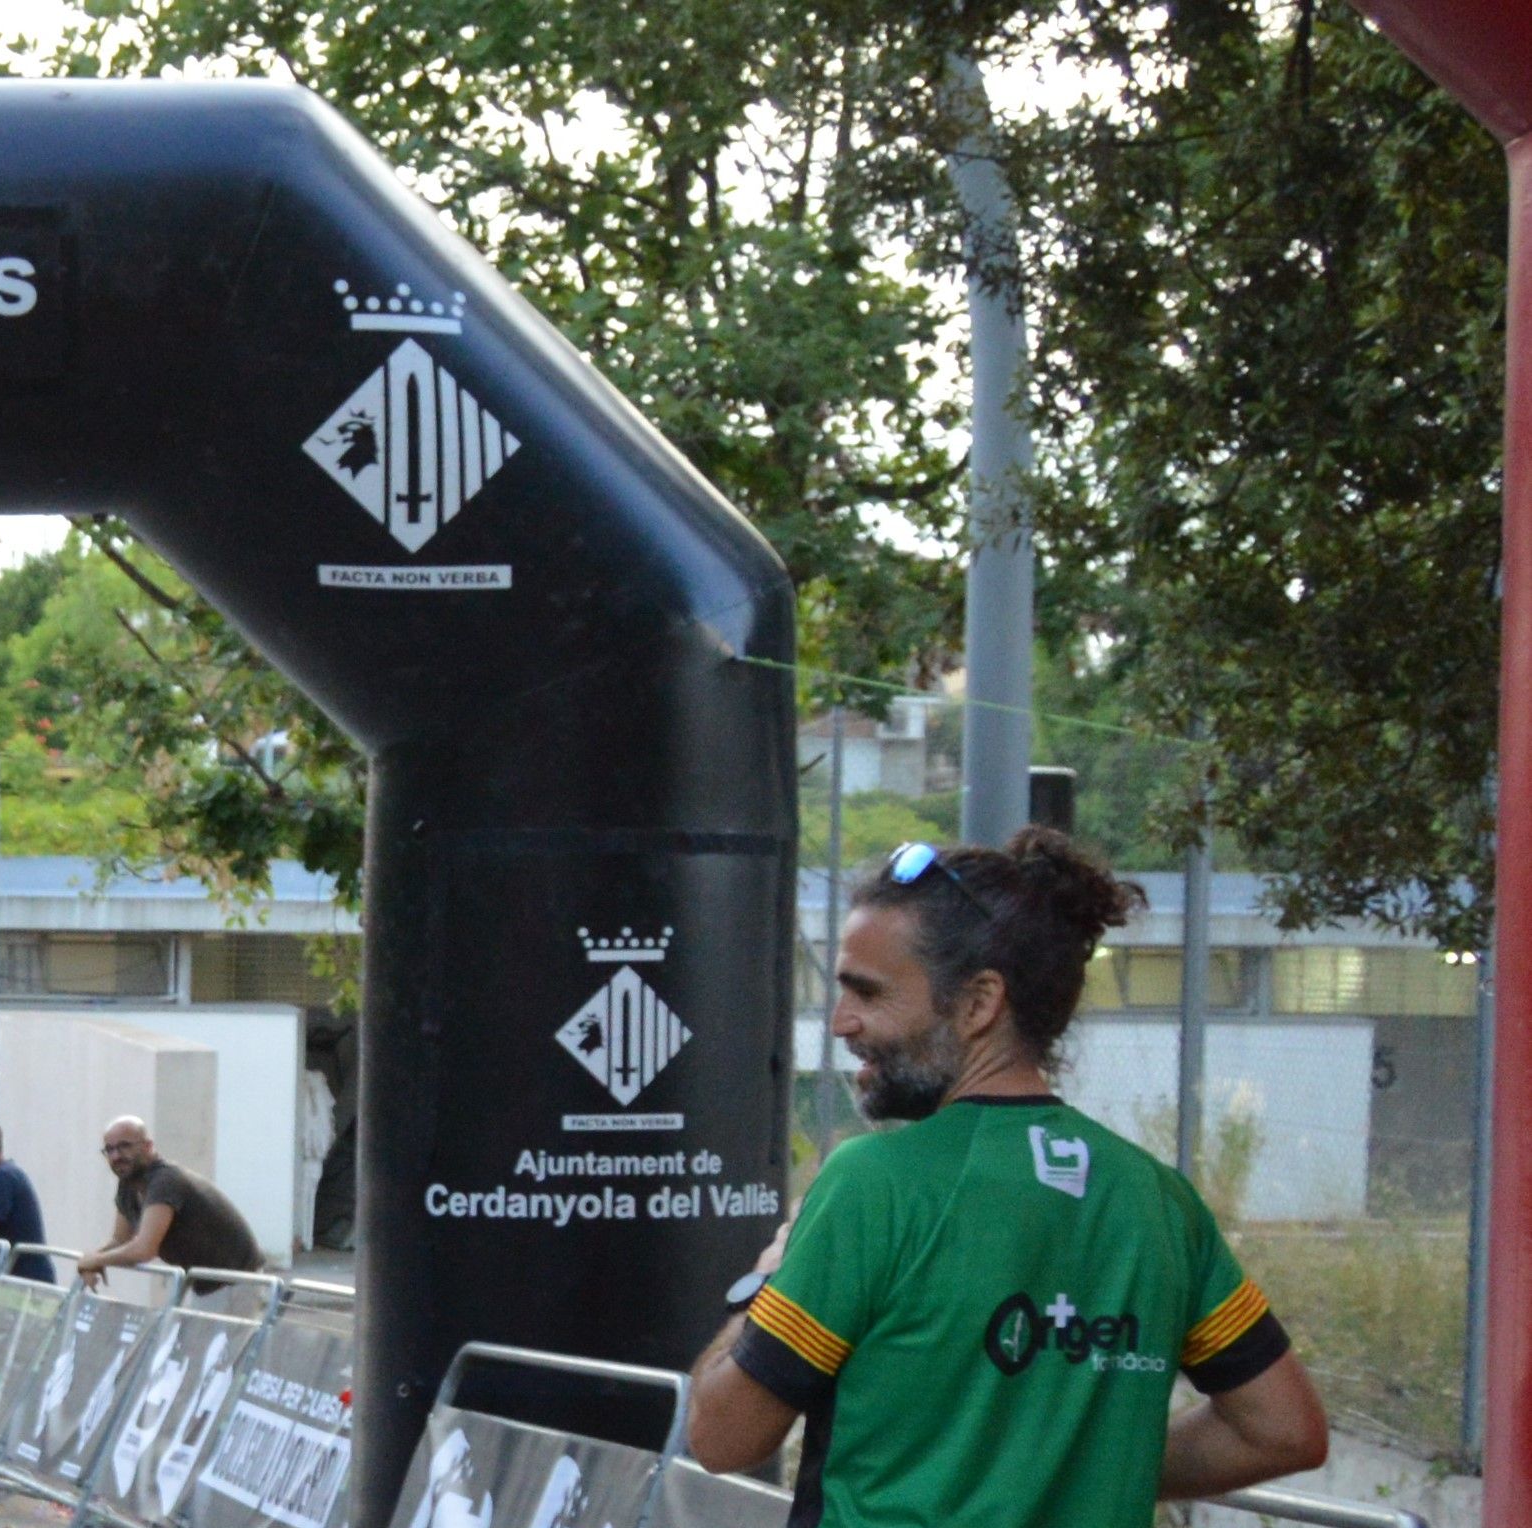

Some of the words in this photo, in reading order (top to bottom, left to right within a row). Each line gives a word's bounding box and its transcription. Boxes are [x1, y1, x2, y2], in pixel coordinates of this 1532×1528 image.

[331, 570, 386, 584] FACTA
[392, 571, 431, 585] NON
[438, 571, 500, 585] VERBA
[514, 1149, 686, 1182] Ajuntament
[691, 1149, 722, 1175] de
[424, 1183, 636, 1228] Cerdanyola
[648, 1185, 700, 1219] del
[709, 1182, 779, 1217] Vallès
